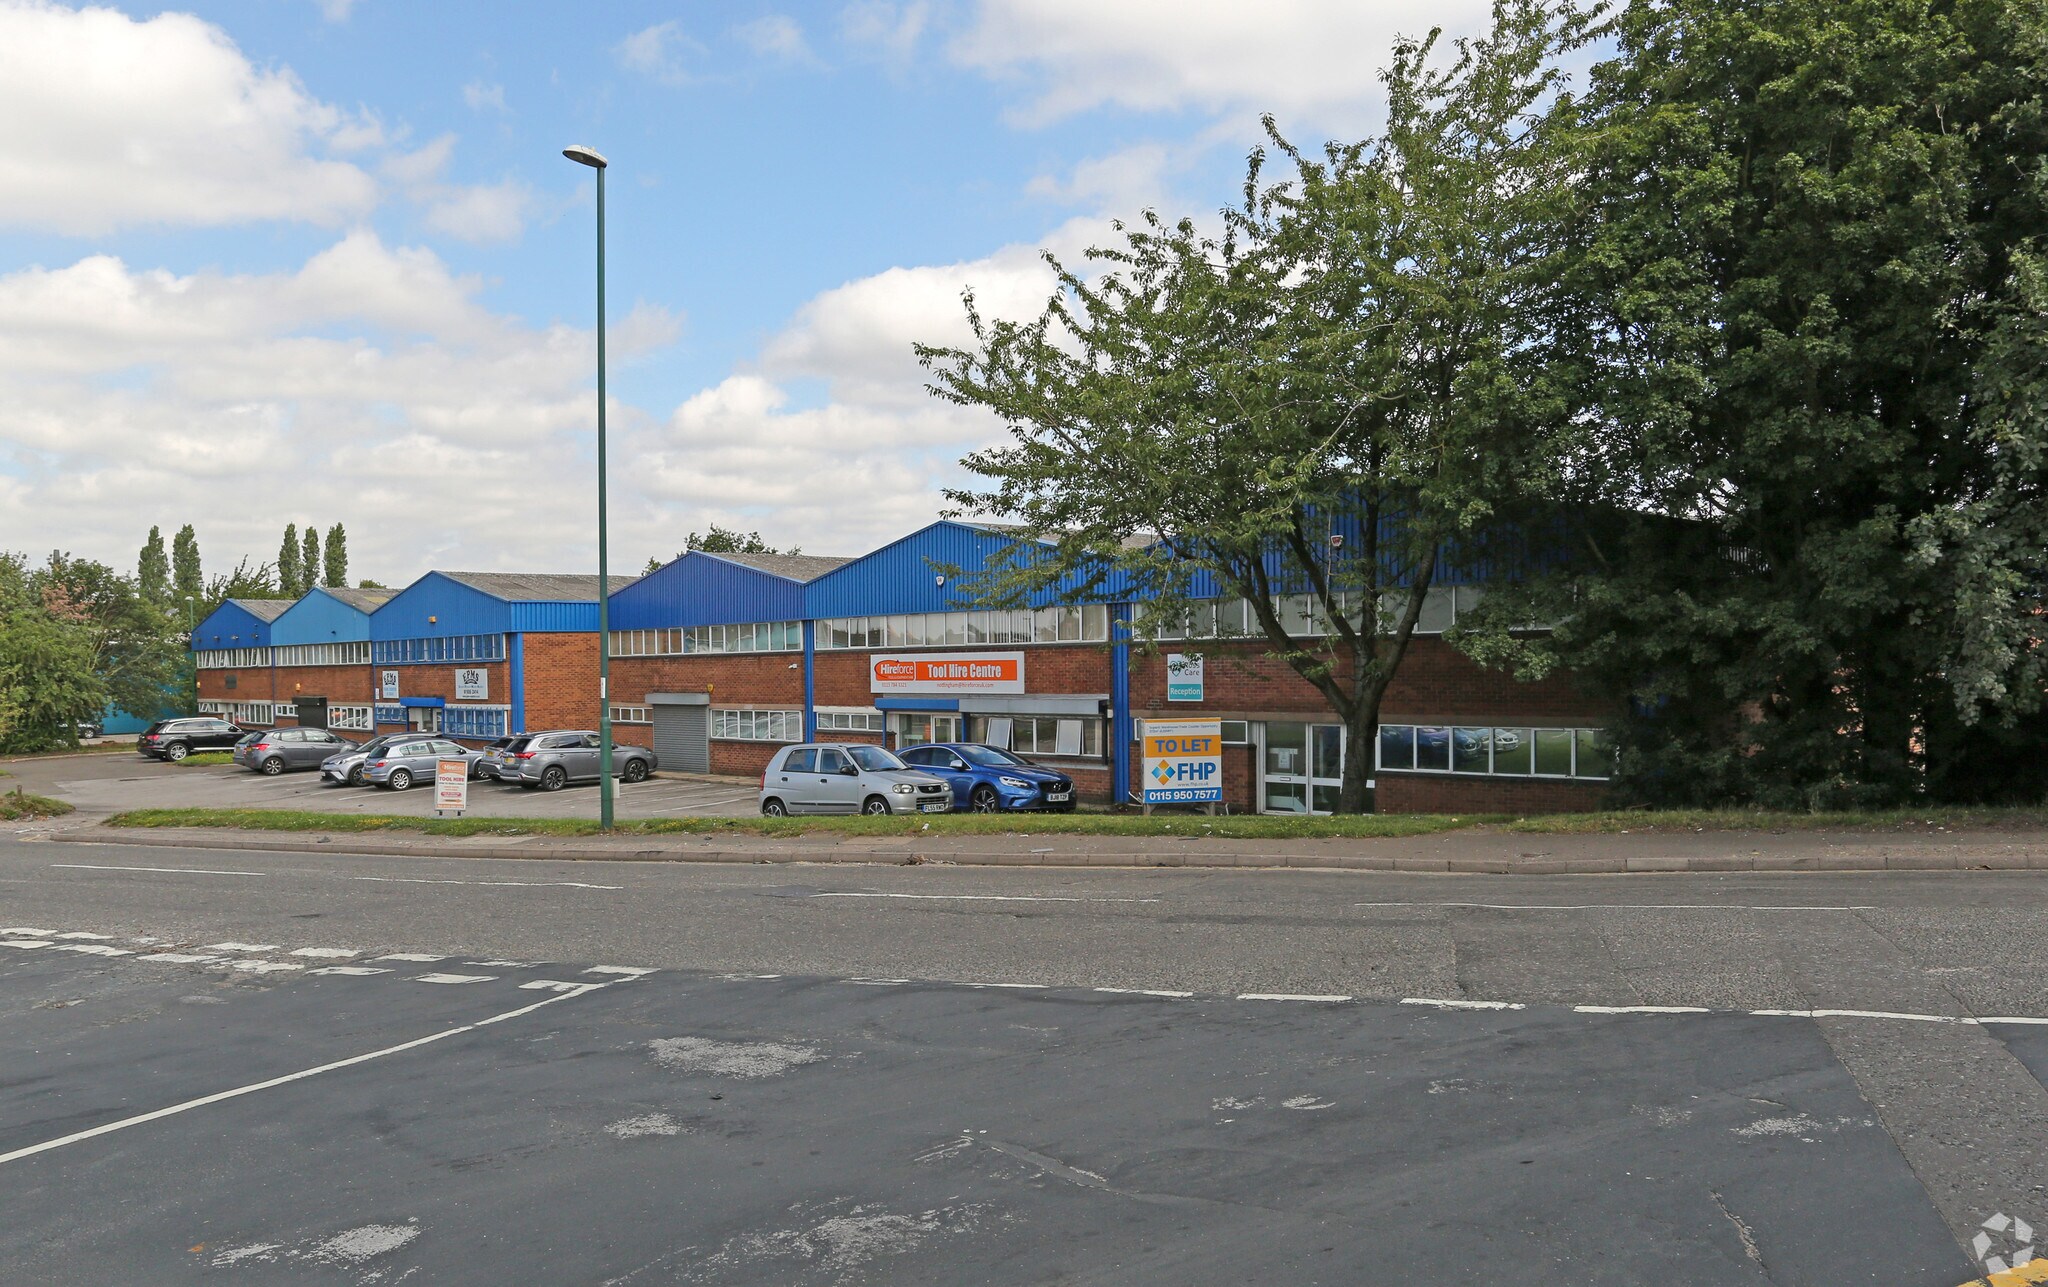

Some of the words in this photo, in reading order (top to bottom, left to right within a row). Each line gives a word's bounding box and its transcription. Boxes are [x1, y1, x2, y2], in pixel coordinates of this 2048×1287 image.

[462, 669, 480, 682] EPMS
[880, 664, 914, 675] Hireforce
[927, 663, 947, 678] Tool
[949, 663, 967, 678] Hire
[969, 663, 1002, 678] Centre
[1170, 687, 1201, 696] Reception
[1155, 739, 1178, 753] TO
[1181, 738, 1212, 753] LET
[1177, 761, 1217, 781] FHP
[1149, 791, 1172, 801] 0115
[1173, 790, 1193, 800] 950
[1194, 789, 1218, 799] 7577
